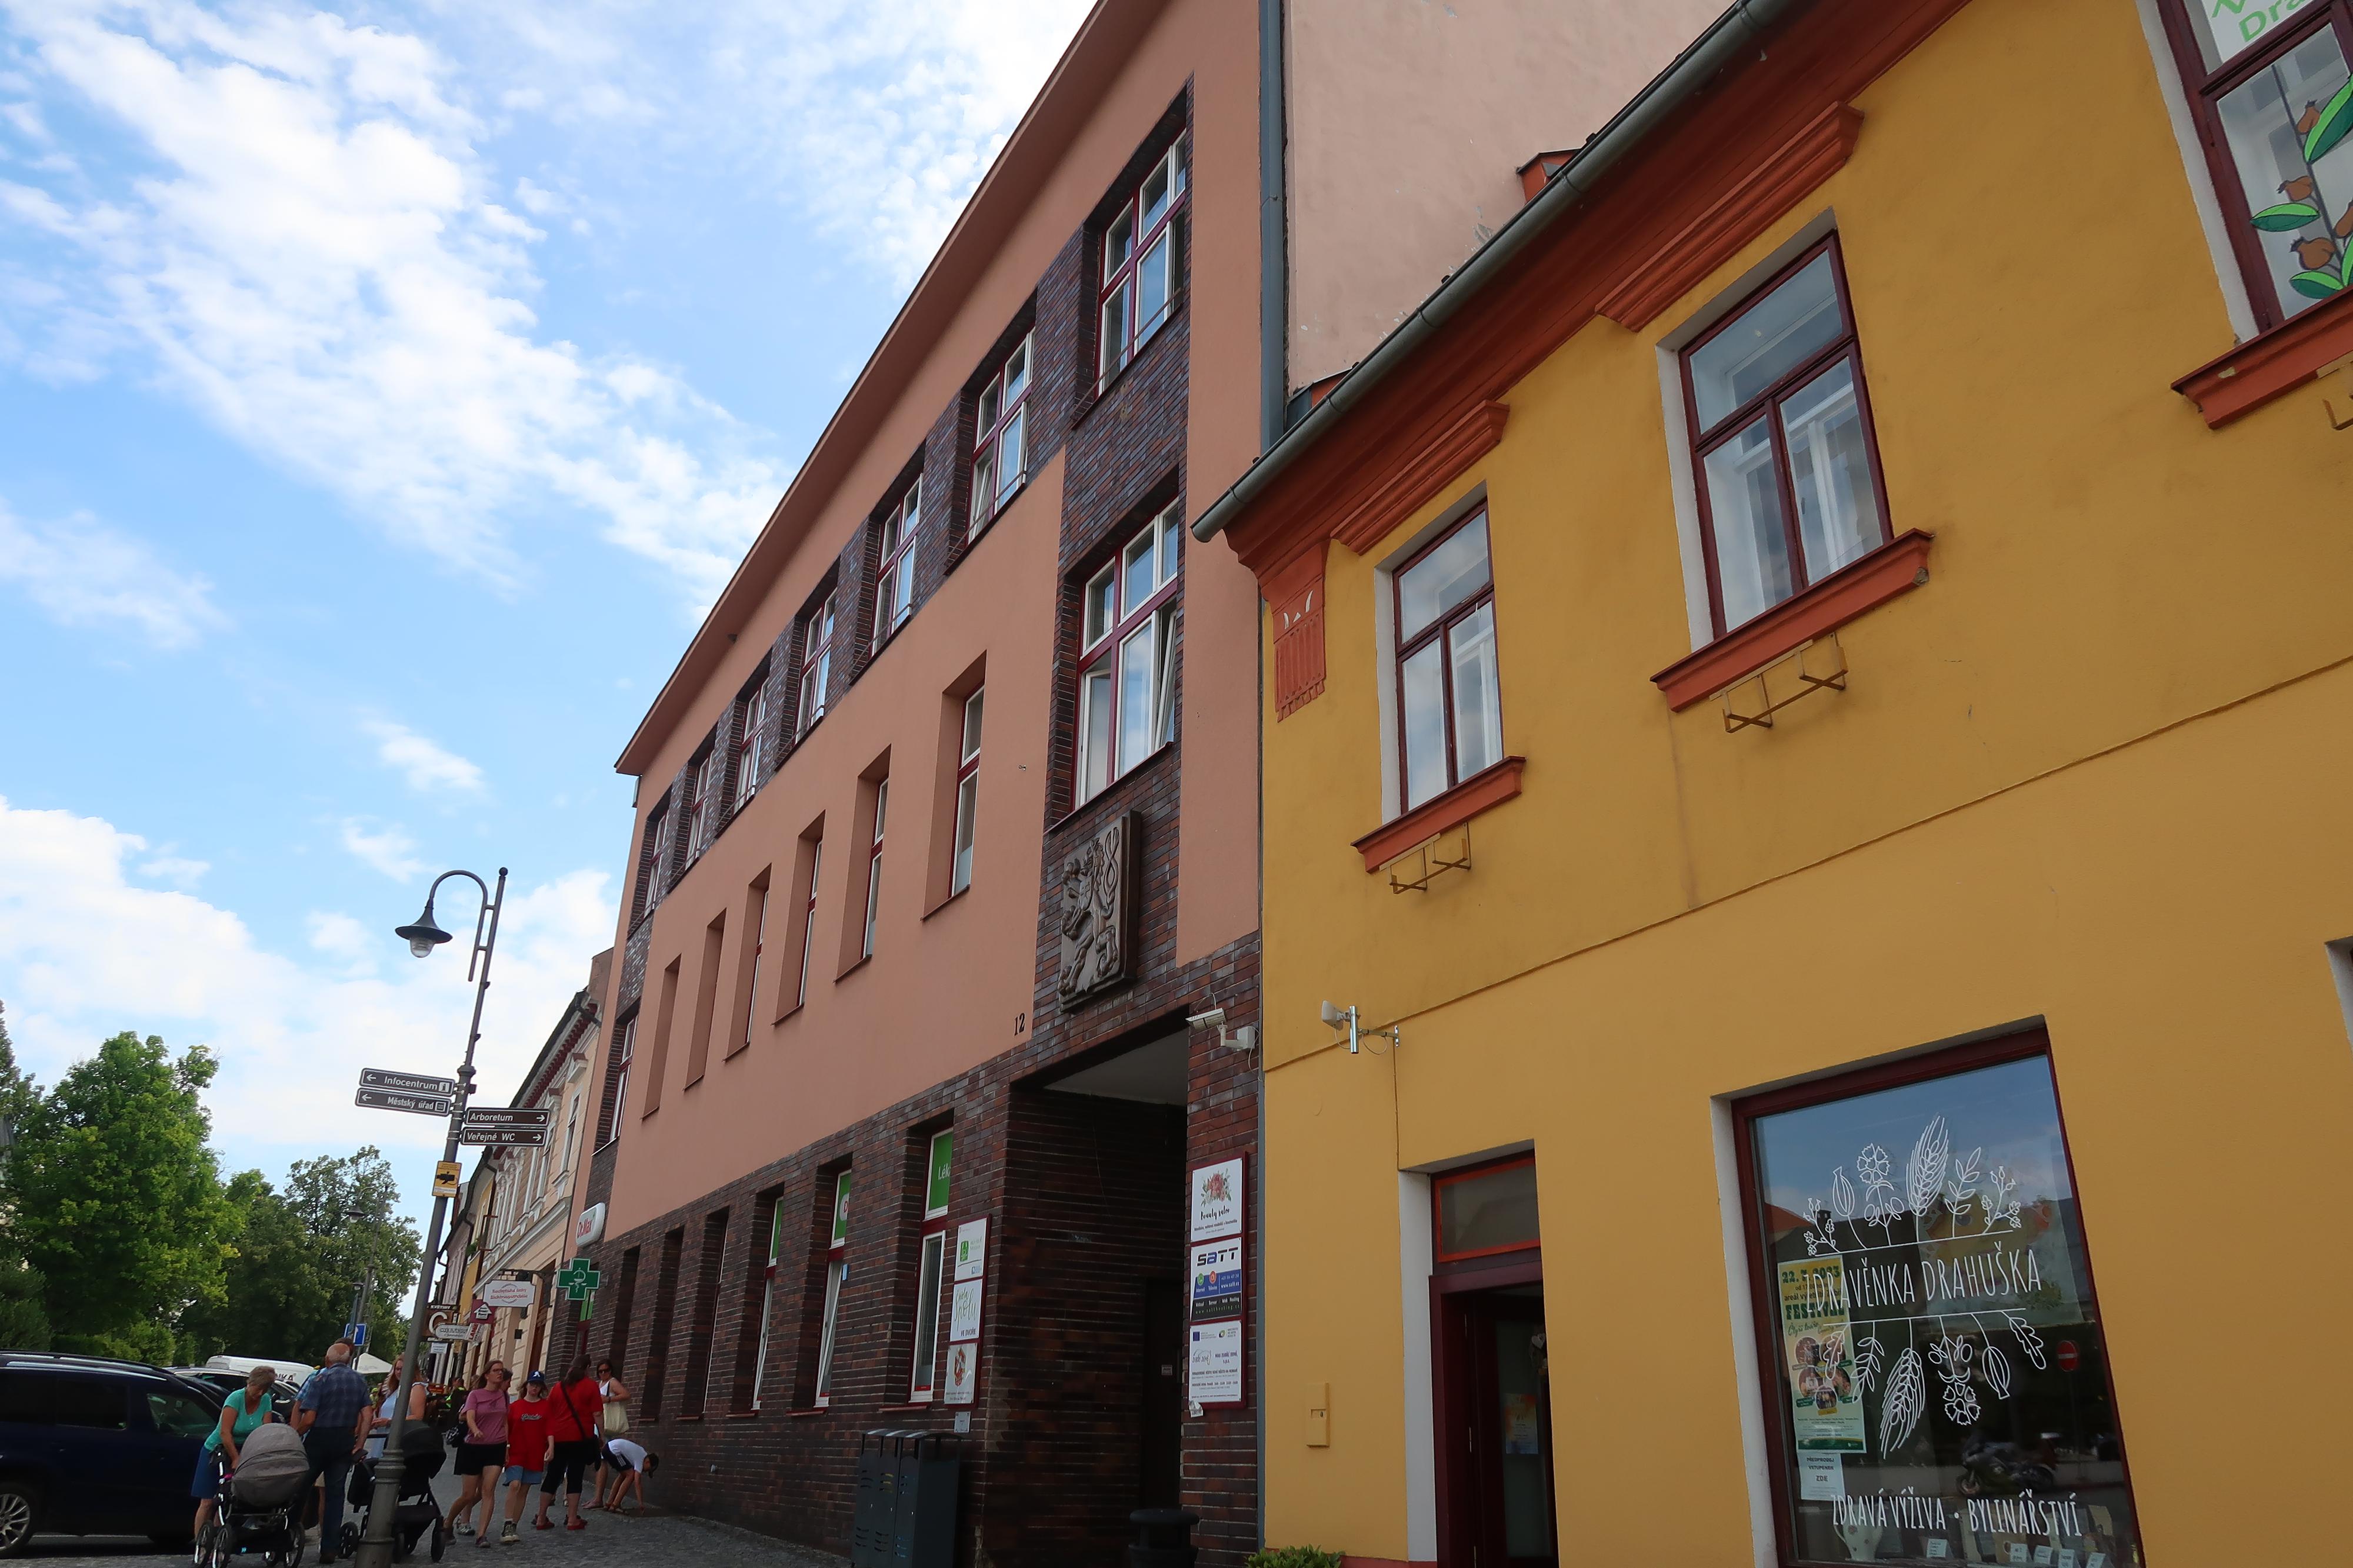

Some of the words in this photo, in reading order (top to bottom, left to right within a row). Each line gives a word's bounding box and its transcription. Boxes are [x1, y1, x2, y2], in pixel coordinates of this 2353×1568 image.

[1014, 1012, 1025, 1036] 12
[384, 1076, 438, 1090] Infocentrum
[387, 1096, 416, 1109] Městský
[418, 1099, 434, 1110] úřad
[469, 1112, 514, 1122] Arboretum
[467, 1131, 497, 1142] Veřejné
[502, 1133, 516, 1141] WC
[938, 1163, 951, 1180] Lék
[1803, 1257, 1915, 1313] ZDRAVĚNKA
[1921, 1240, 2042, 1302] DRAHUŠKA
[1831, 1488, 1887, 1528] ZDRAVÁ
[1889, 1486, 1947, 1531] VÝŽIVA
[1967, 1489, 2082, 1537] BYLINÁŘSTVÍ
